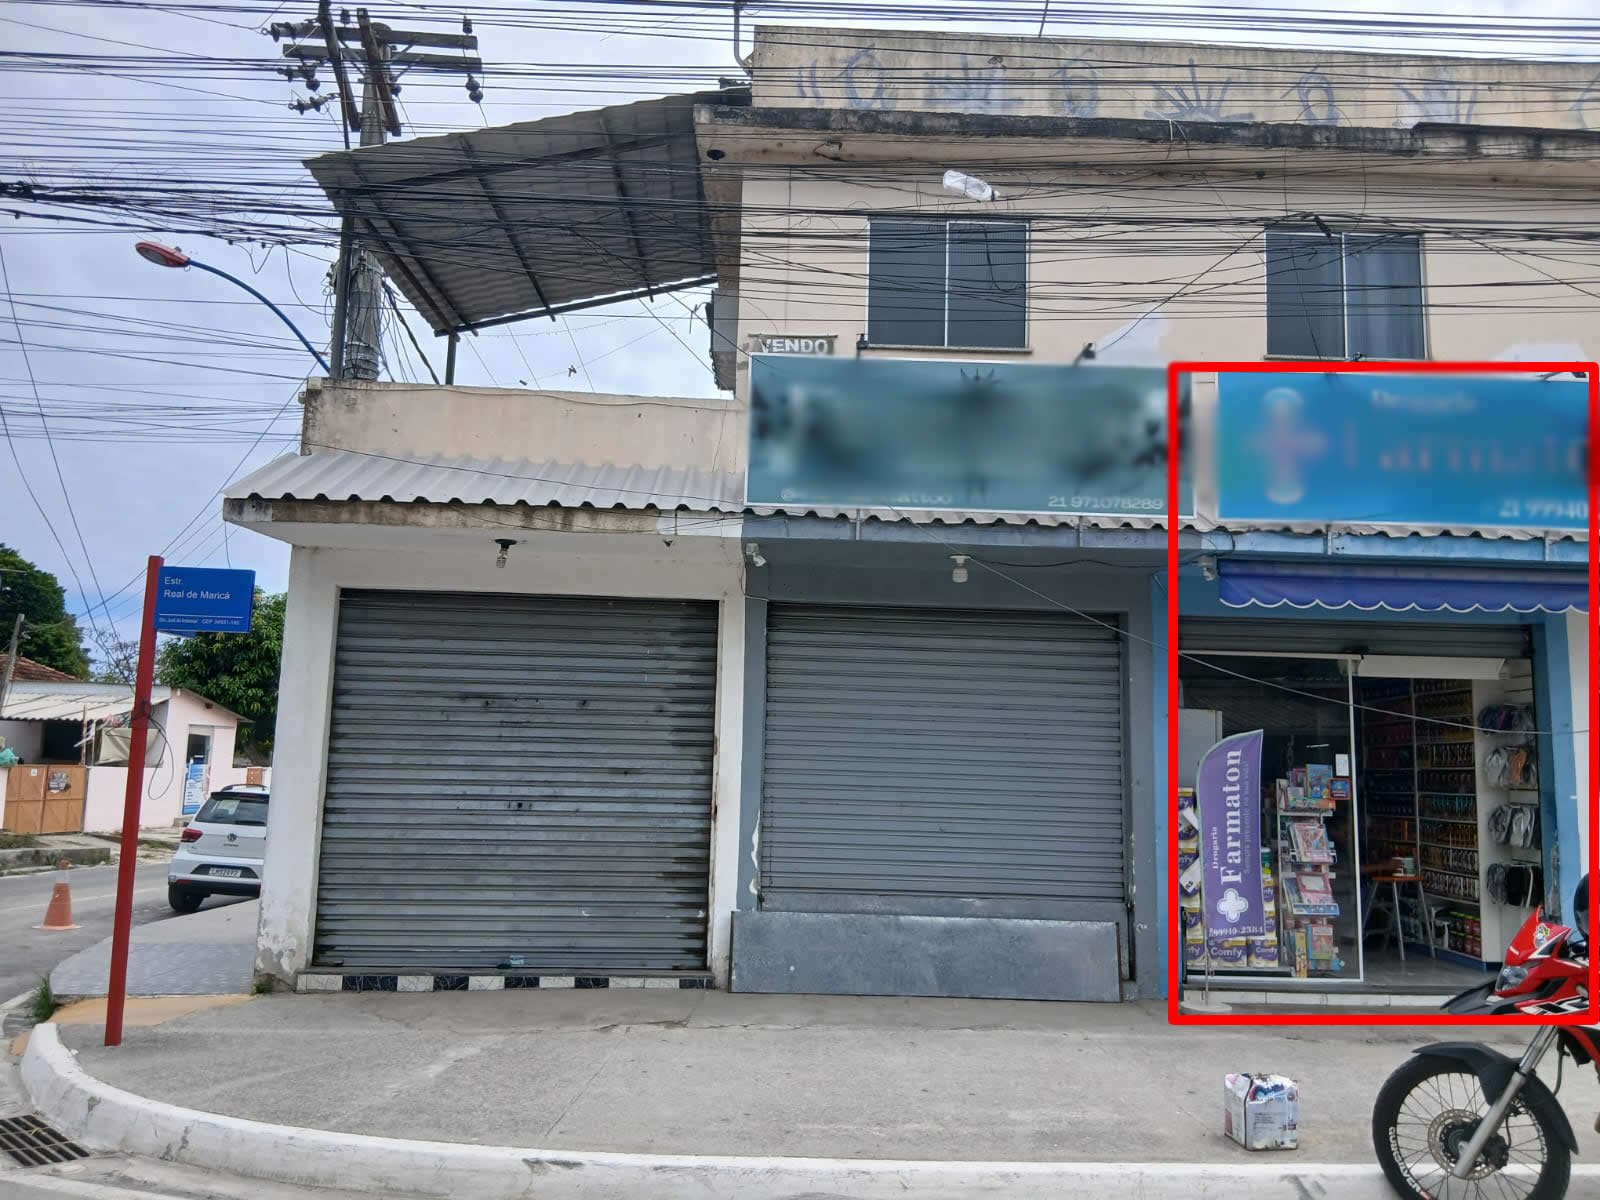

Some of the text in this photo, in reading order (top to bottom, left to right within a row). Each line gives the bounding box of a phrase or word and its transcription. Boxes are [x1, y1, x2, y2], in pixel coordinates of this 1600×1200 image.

[759, 338, 828, 353] VENDO
[1048, 496, 1067, 507] 21
[164, 576, 183, 585] Estr.
[164, 589, 231, 600] Real de Maricá
[1220, 749, 1242, 885] Farmaton
[1210, 826, 1219, 869] Drogaria
[1210, 946, 1242, 958] Comfy
[1255, 946, 1278, 956] Comfy
